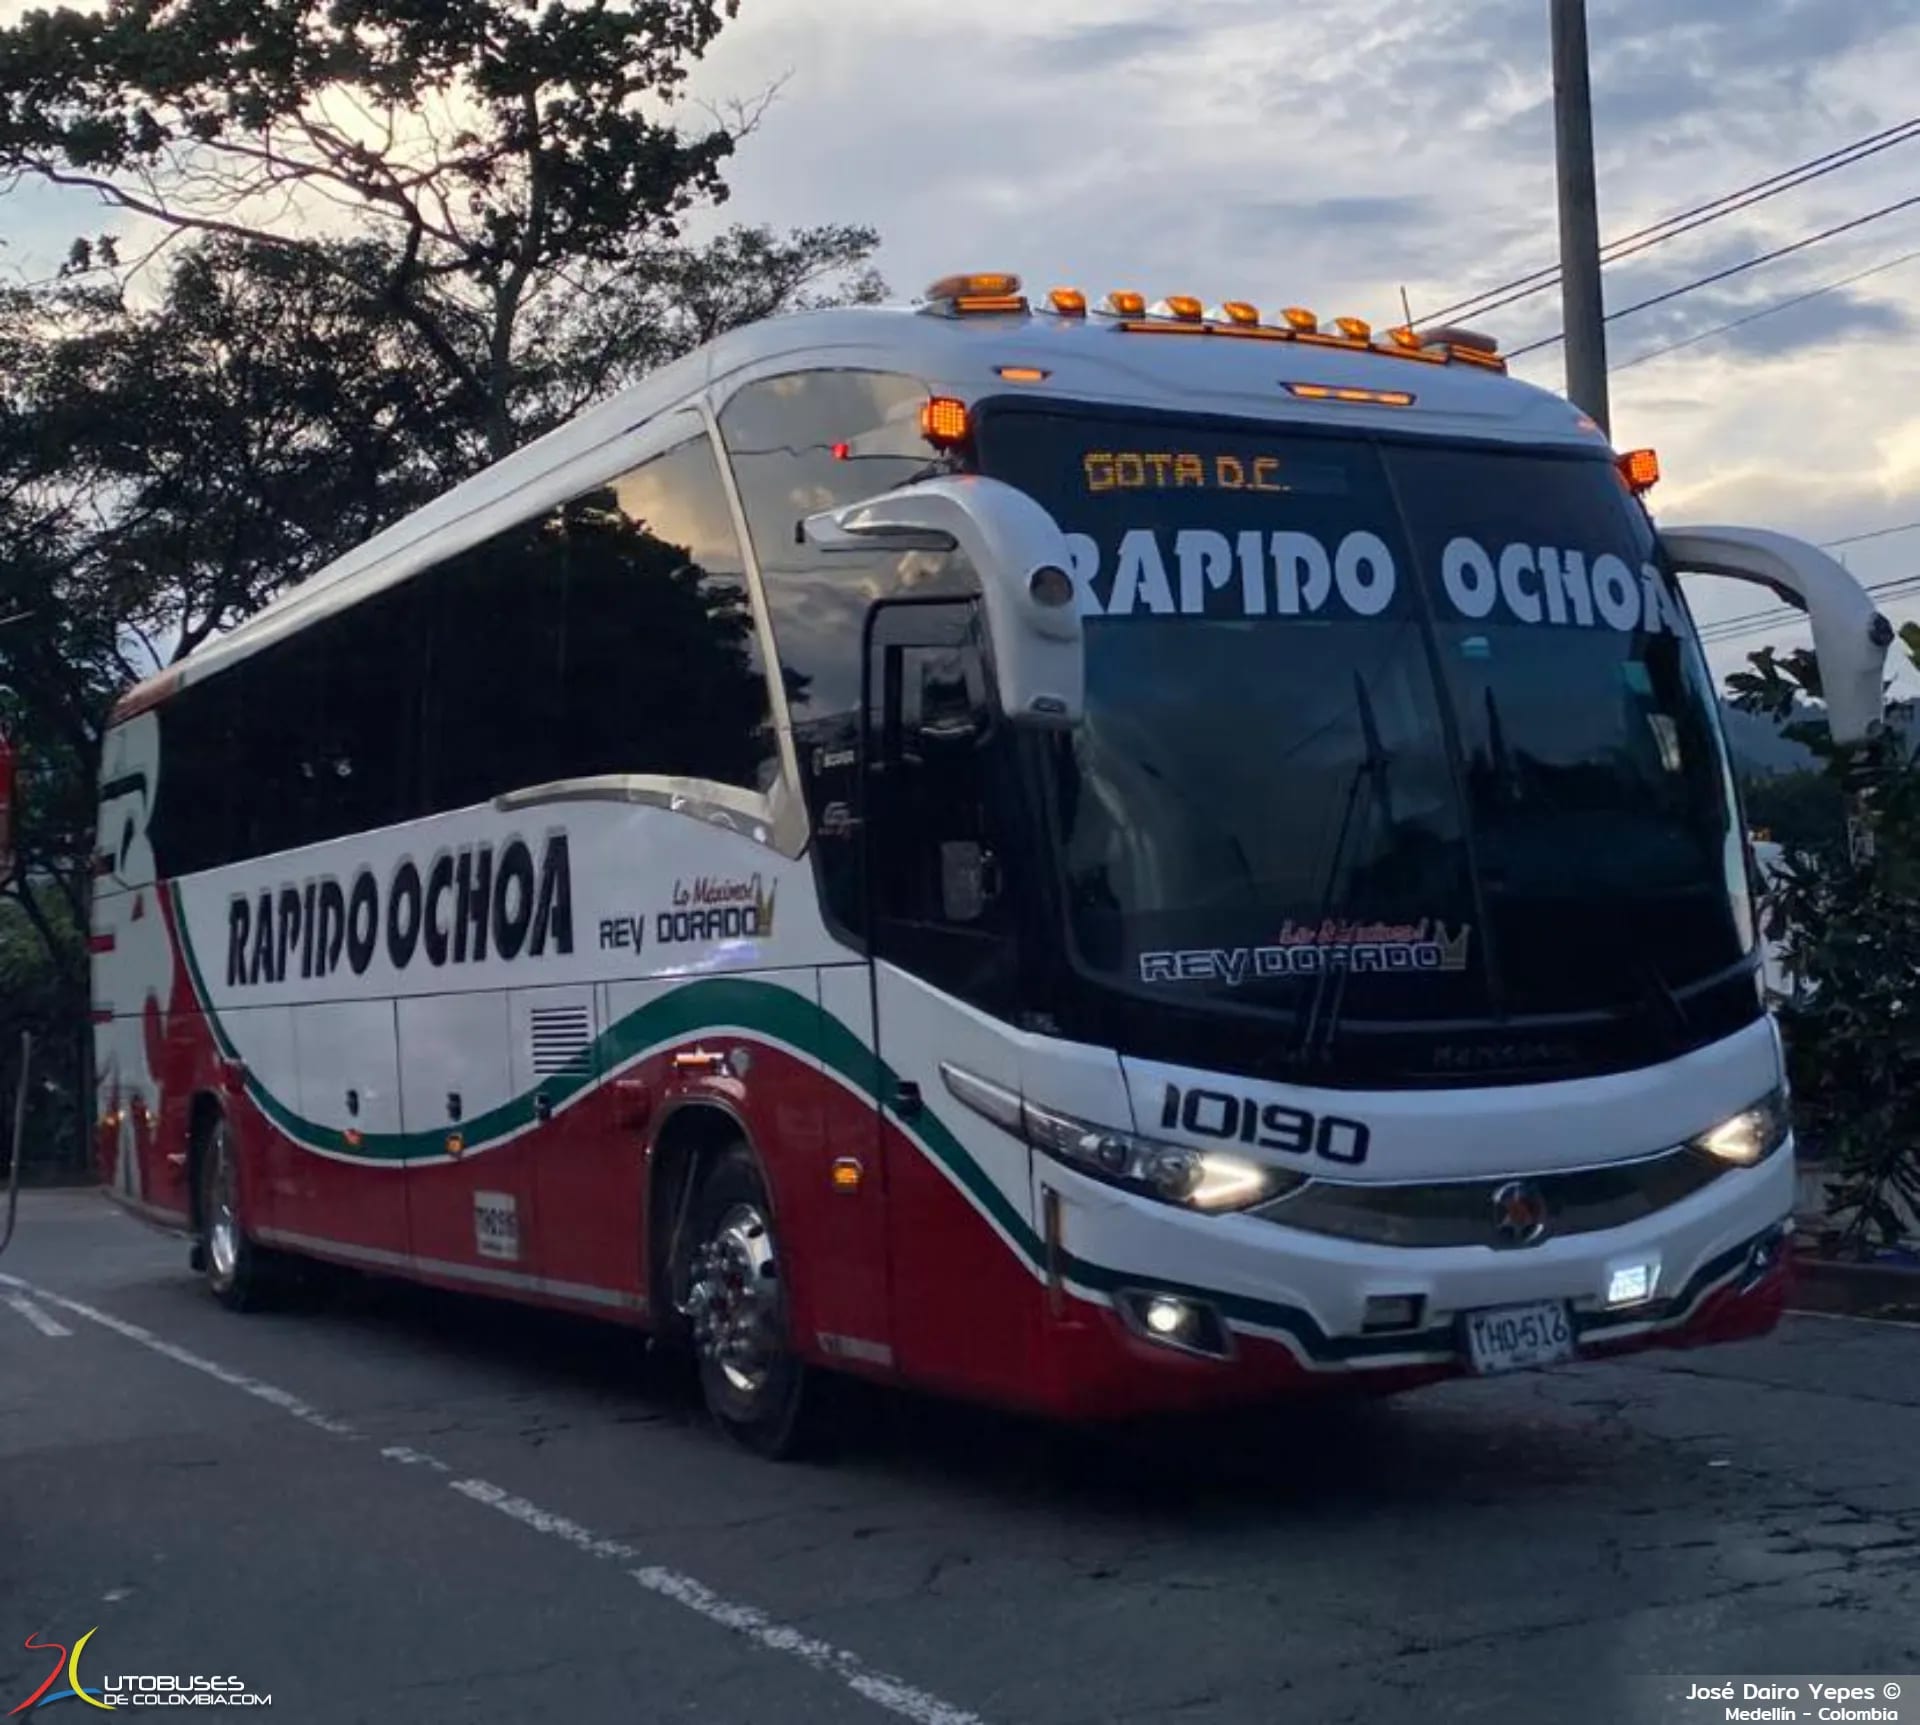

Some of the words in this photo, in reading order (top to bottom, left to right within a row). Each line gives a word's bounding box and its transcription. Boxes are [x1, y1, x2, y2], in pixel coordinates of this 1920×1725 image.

[1441, 536, 1684, 638] OCHOA
[227, 866, 379, 987] RAPIDO
[386, 829, 574, 969] OCHOA
[600, 914, 645, 955] REY
[656, 906, 759, 944] DORADO
[1139, 947, 1249, 986] REY
[1160, 1081, 1371, 1166] 10190
